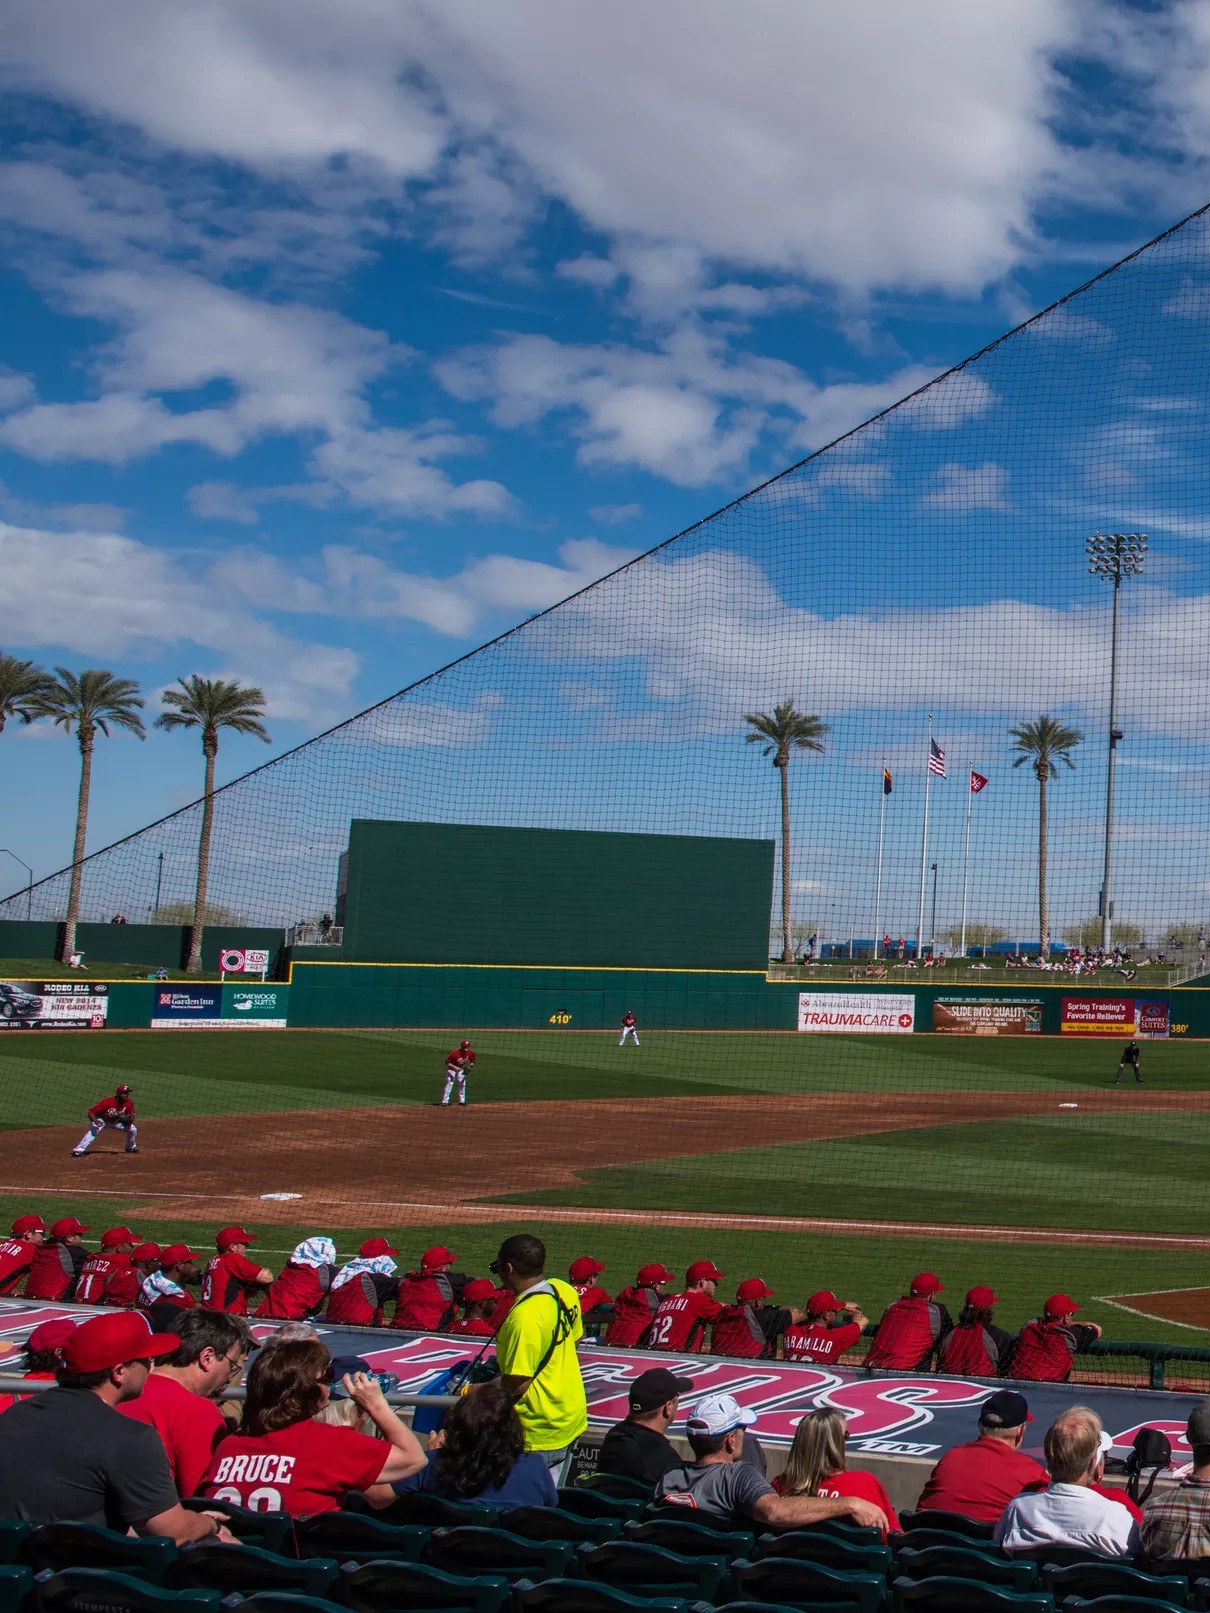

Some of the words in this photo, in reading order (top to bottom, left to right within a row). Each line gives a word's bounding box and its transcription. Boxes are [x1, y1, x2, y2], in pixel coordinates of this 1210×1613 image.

[951, 1006, 972, 1017] SLIDE
[973, 1006, 992, 1017] INTO
[993, 1006, 1027, 1018] QUALITY
[1067, 1003, 1090, 1012] Spring
[1091, 1003, 1126, 1013] Training's
[549, 1014, 572, 1024] 410'
[804, 1012, 896, 1026] TRAUMACARE
[783, 1335, 833, 1354] ARAMILLO
[572, 1448, 600, 1461] CAUT
[213, 1454, 296, 1484] BRUCE
[577, 1460, 599, 1469] BEWAR
